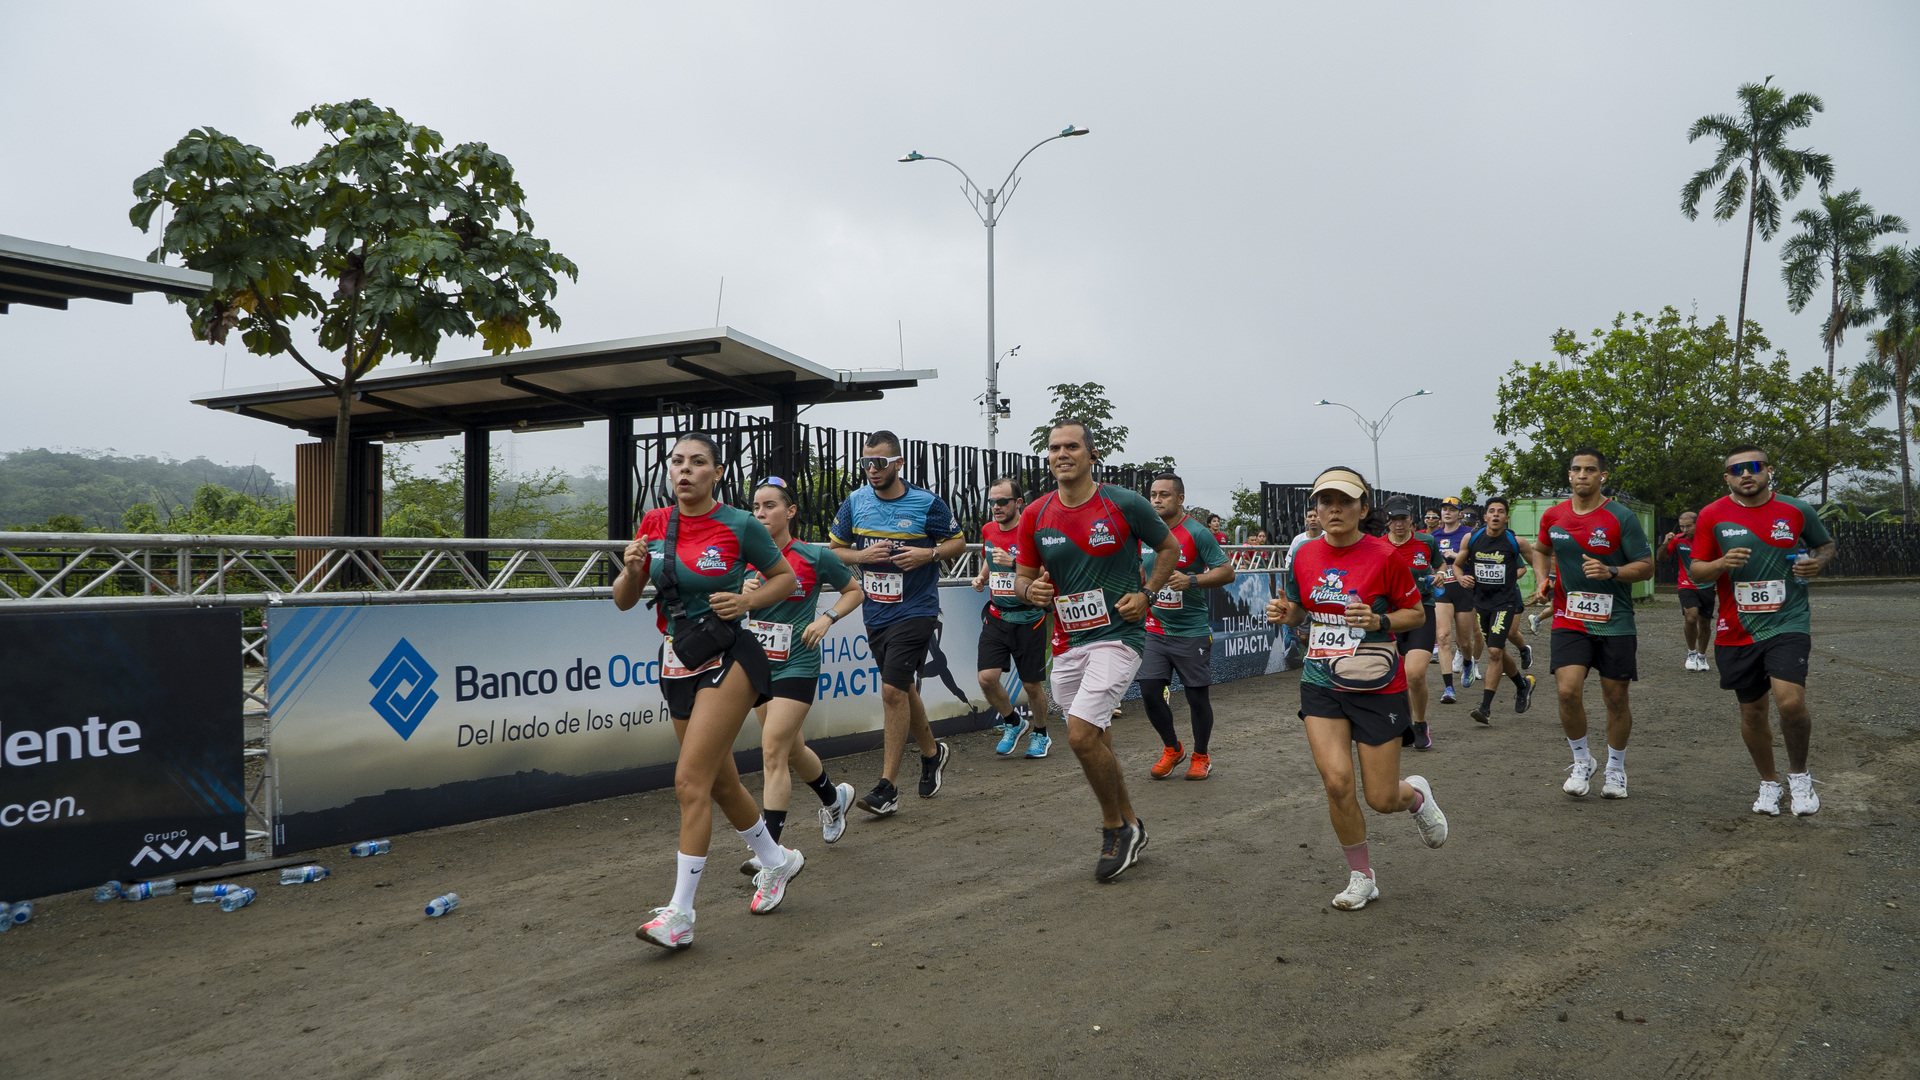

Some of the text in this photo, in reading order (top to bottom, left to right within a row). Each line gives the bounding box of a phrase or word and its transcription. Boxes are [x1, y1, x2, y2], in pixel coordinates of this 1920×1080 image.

[1479, 569, 1500, 578] 6105
[871, 581, 890, 593] 611
[996, 579, 1012, 588] 176
[1751, 591, 1769, 602] 86
[1065, 603, 1098, 620] 1010
[1577, 601, 1600, 613] 443
[1222, 616, 1235, 634] TU
[1225, 634, 1272, 657] IMPACTA.
[1318, 631, 1346, 647] 494
[821, 634, 876, 664] HAC
[455, 654, 660, 702] Banco de Occ
[457, 719, 495, 748] Del
[501, 715, 550, 743] lado
[555, 711, 581, 735] de
[586, 708, 614, 731] los
[619, 708, 654, 732] que
[0, 716, 142, 768] ente
[143, 829, 188, 844] Grupo
[129, 831, 240, 868] AVAL
